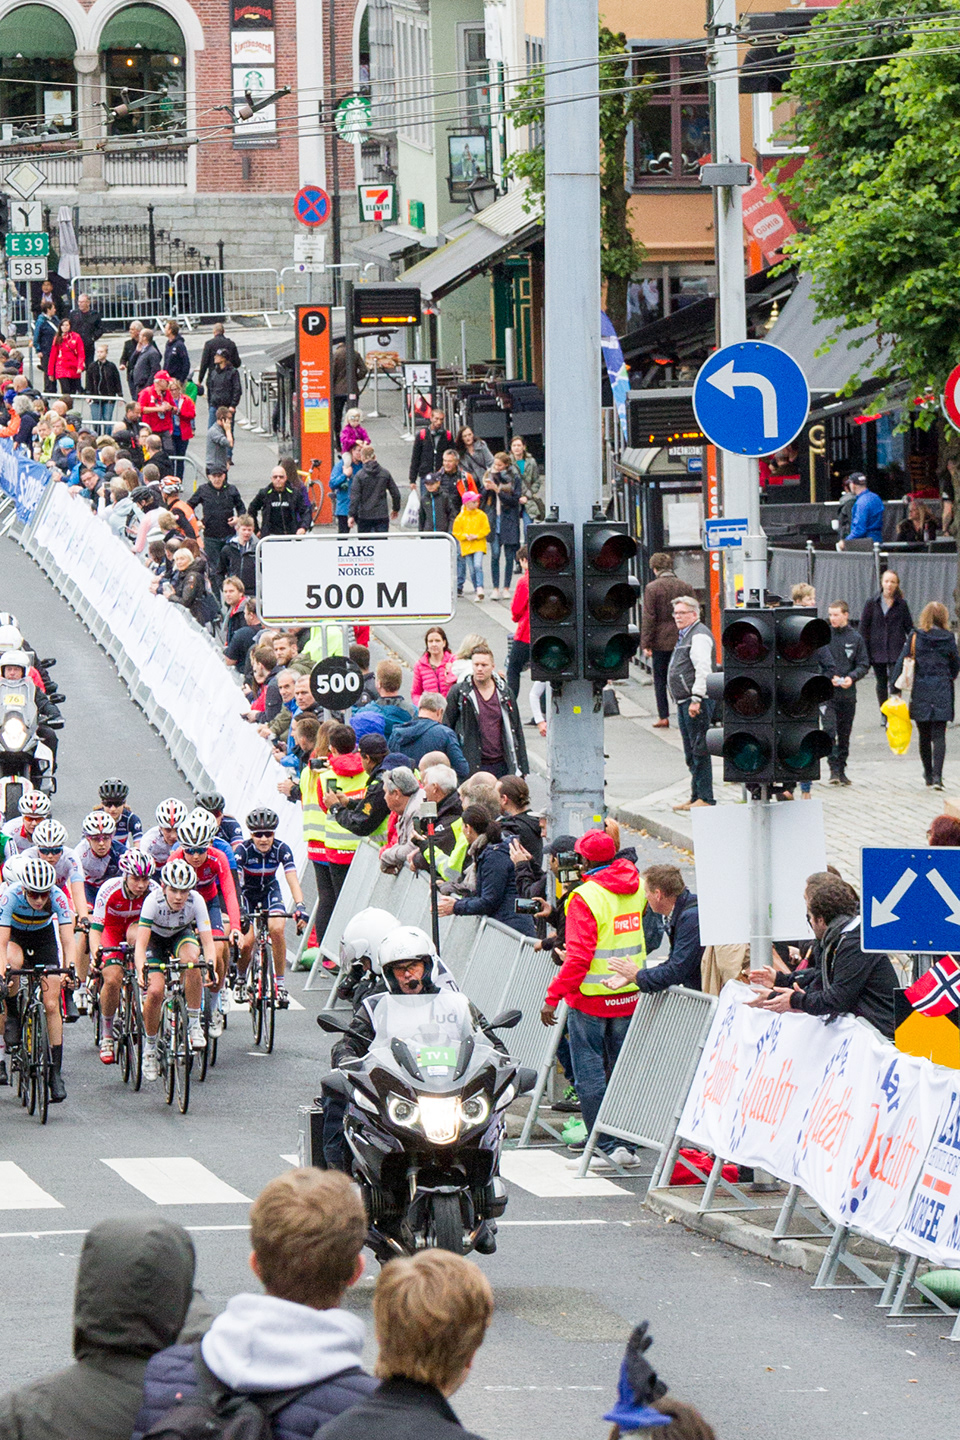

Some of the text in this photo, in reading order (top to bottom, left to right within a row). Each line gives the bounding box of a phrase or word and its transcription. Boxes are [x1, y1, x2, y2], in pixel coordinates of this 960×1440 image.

[12, 238, 44, 252] E 39
[14, 262, 42, 276] 585
[308, 316, 320, 331] P
[338, 546, 375, 557] LAKS
[338, 568, 375, 576] NORGE
[306, 582, 408, 609] 500 M
[316, 672, 360, 694] 500
[614, 920, 630, 930] Tryg
[426, 1051, 449, 1060] TV 1
[740, 1051, 798, 1143] Quality
